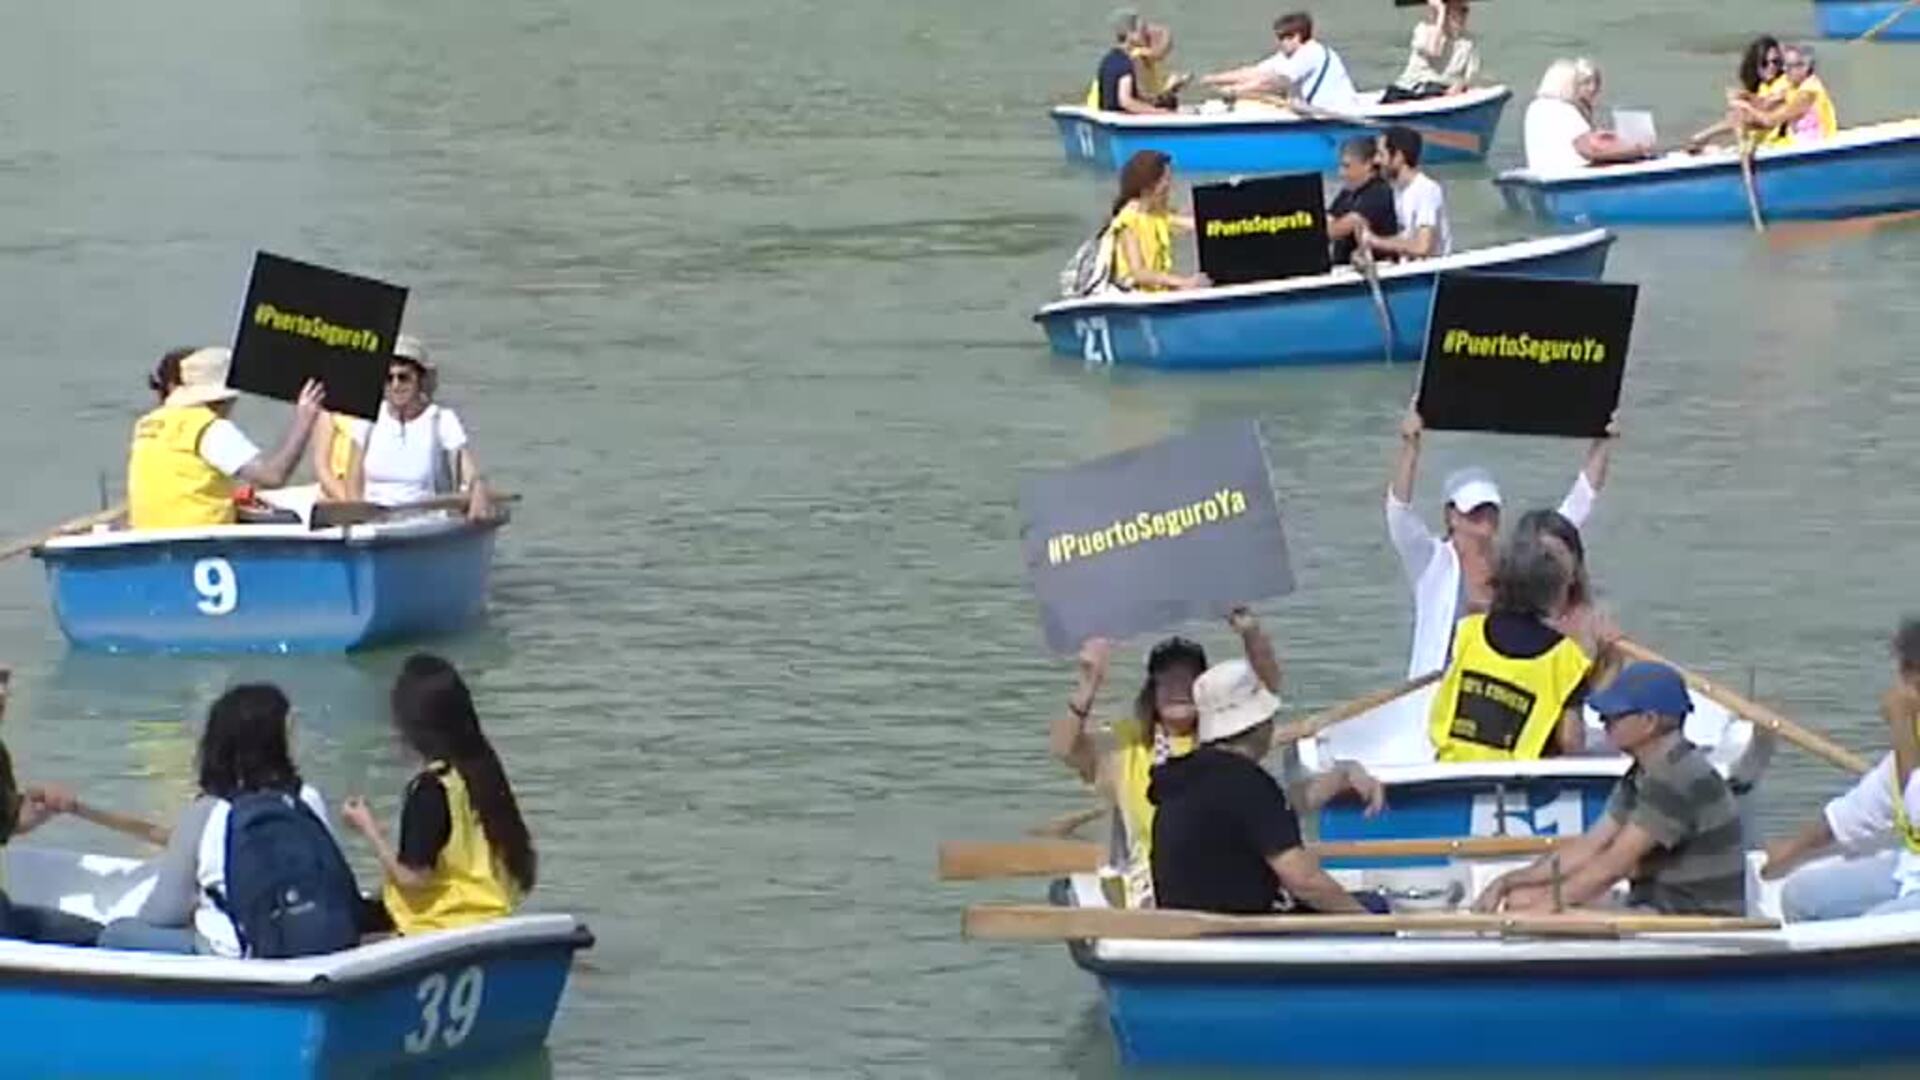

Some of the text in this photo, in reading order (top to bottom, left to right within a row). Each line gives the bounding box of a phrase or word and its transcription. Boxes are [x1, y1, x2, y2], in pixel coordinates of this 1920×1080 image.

[1206, 210, 1313, 236] #PuertoSeguroYa
[254, 303, 379, 352] #PuertoSeguroYa
[1075, 315, 1113, 364] 27
[1443, 329, 1605, 363] #PuertoSeguroYa
[1048, 488, 1246, 565] #PuertoSeguroYa
[193, 558, 237, 615] 9
[404, 966, 484, 1053] 39
